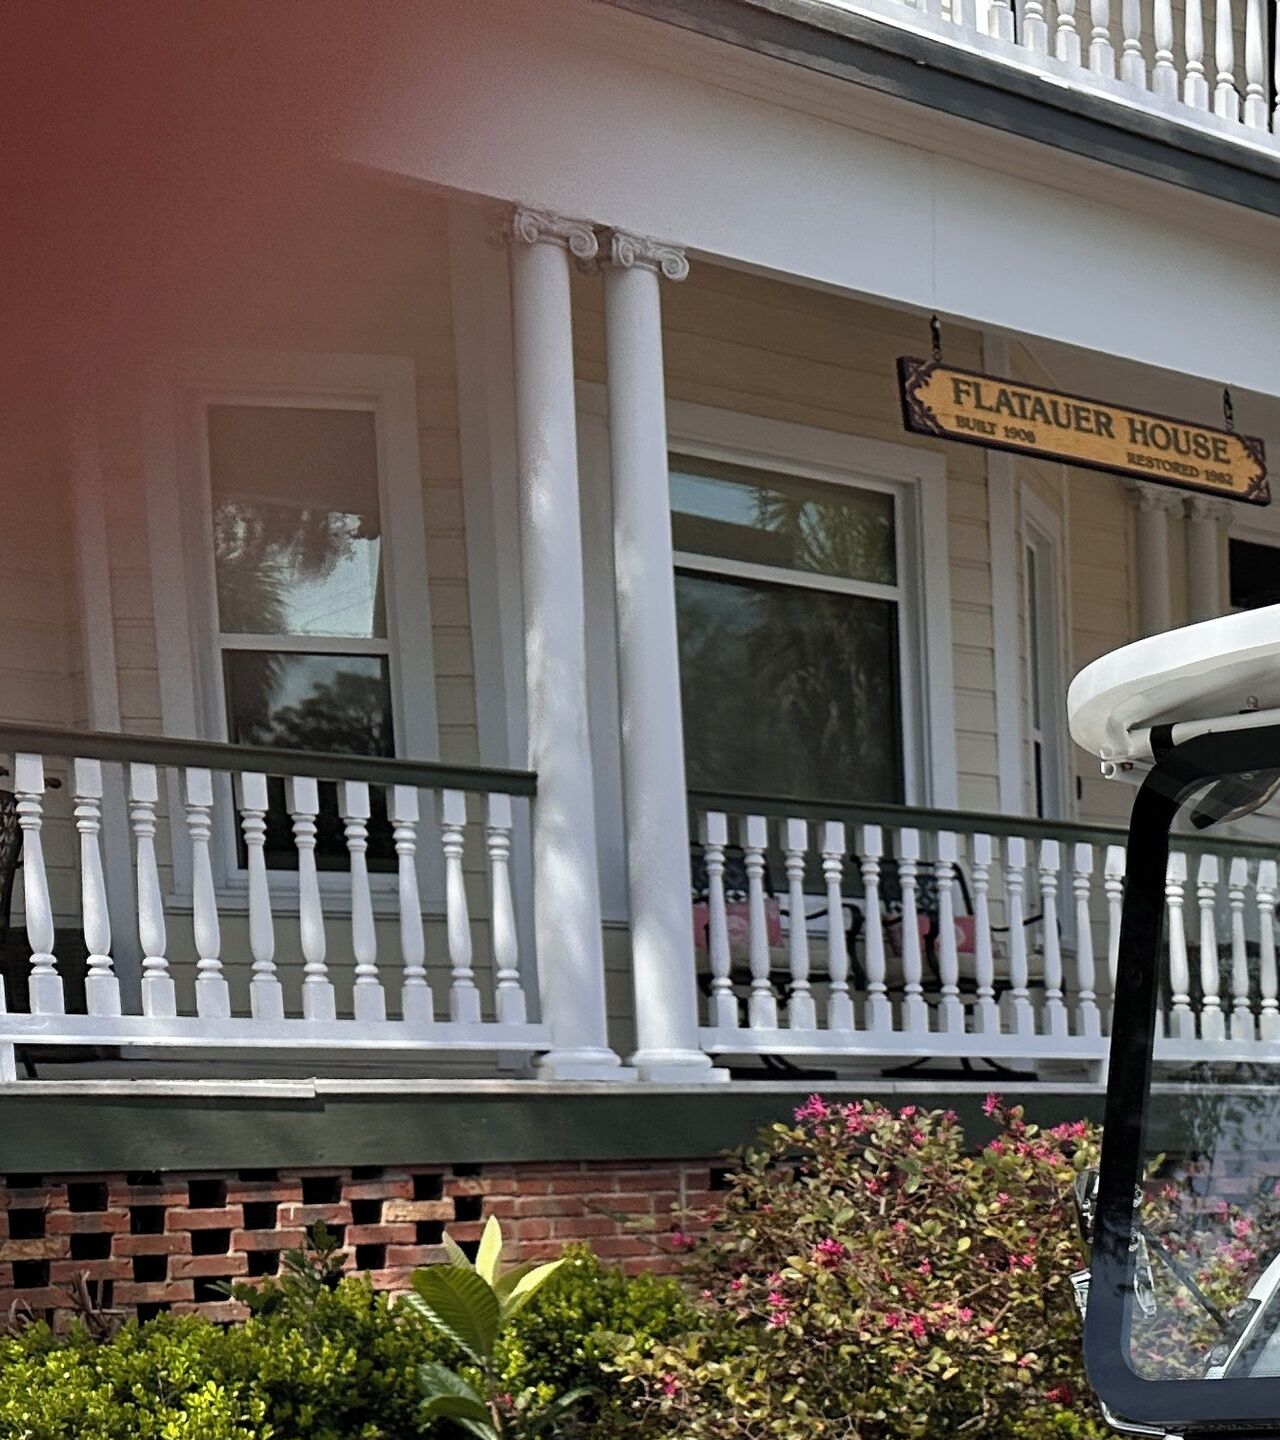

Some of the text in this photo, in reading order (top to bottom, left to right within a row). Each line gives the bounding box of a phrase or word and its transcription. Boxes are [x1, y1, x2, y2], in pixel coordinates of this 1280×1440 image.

[952, 377, 1232, 464] FLATAUER HOUSE
[955, 415, 998, 436] BUILT
[1127, 452, 1200, 477] RESTORED
